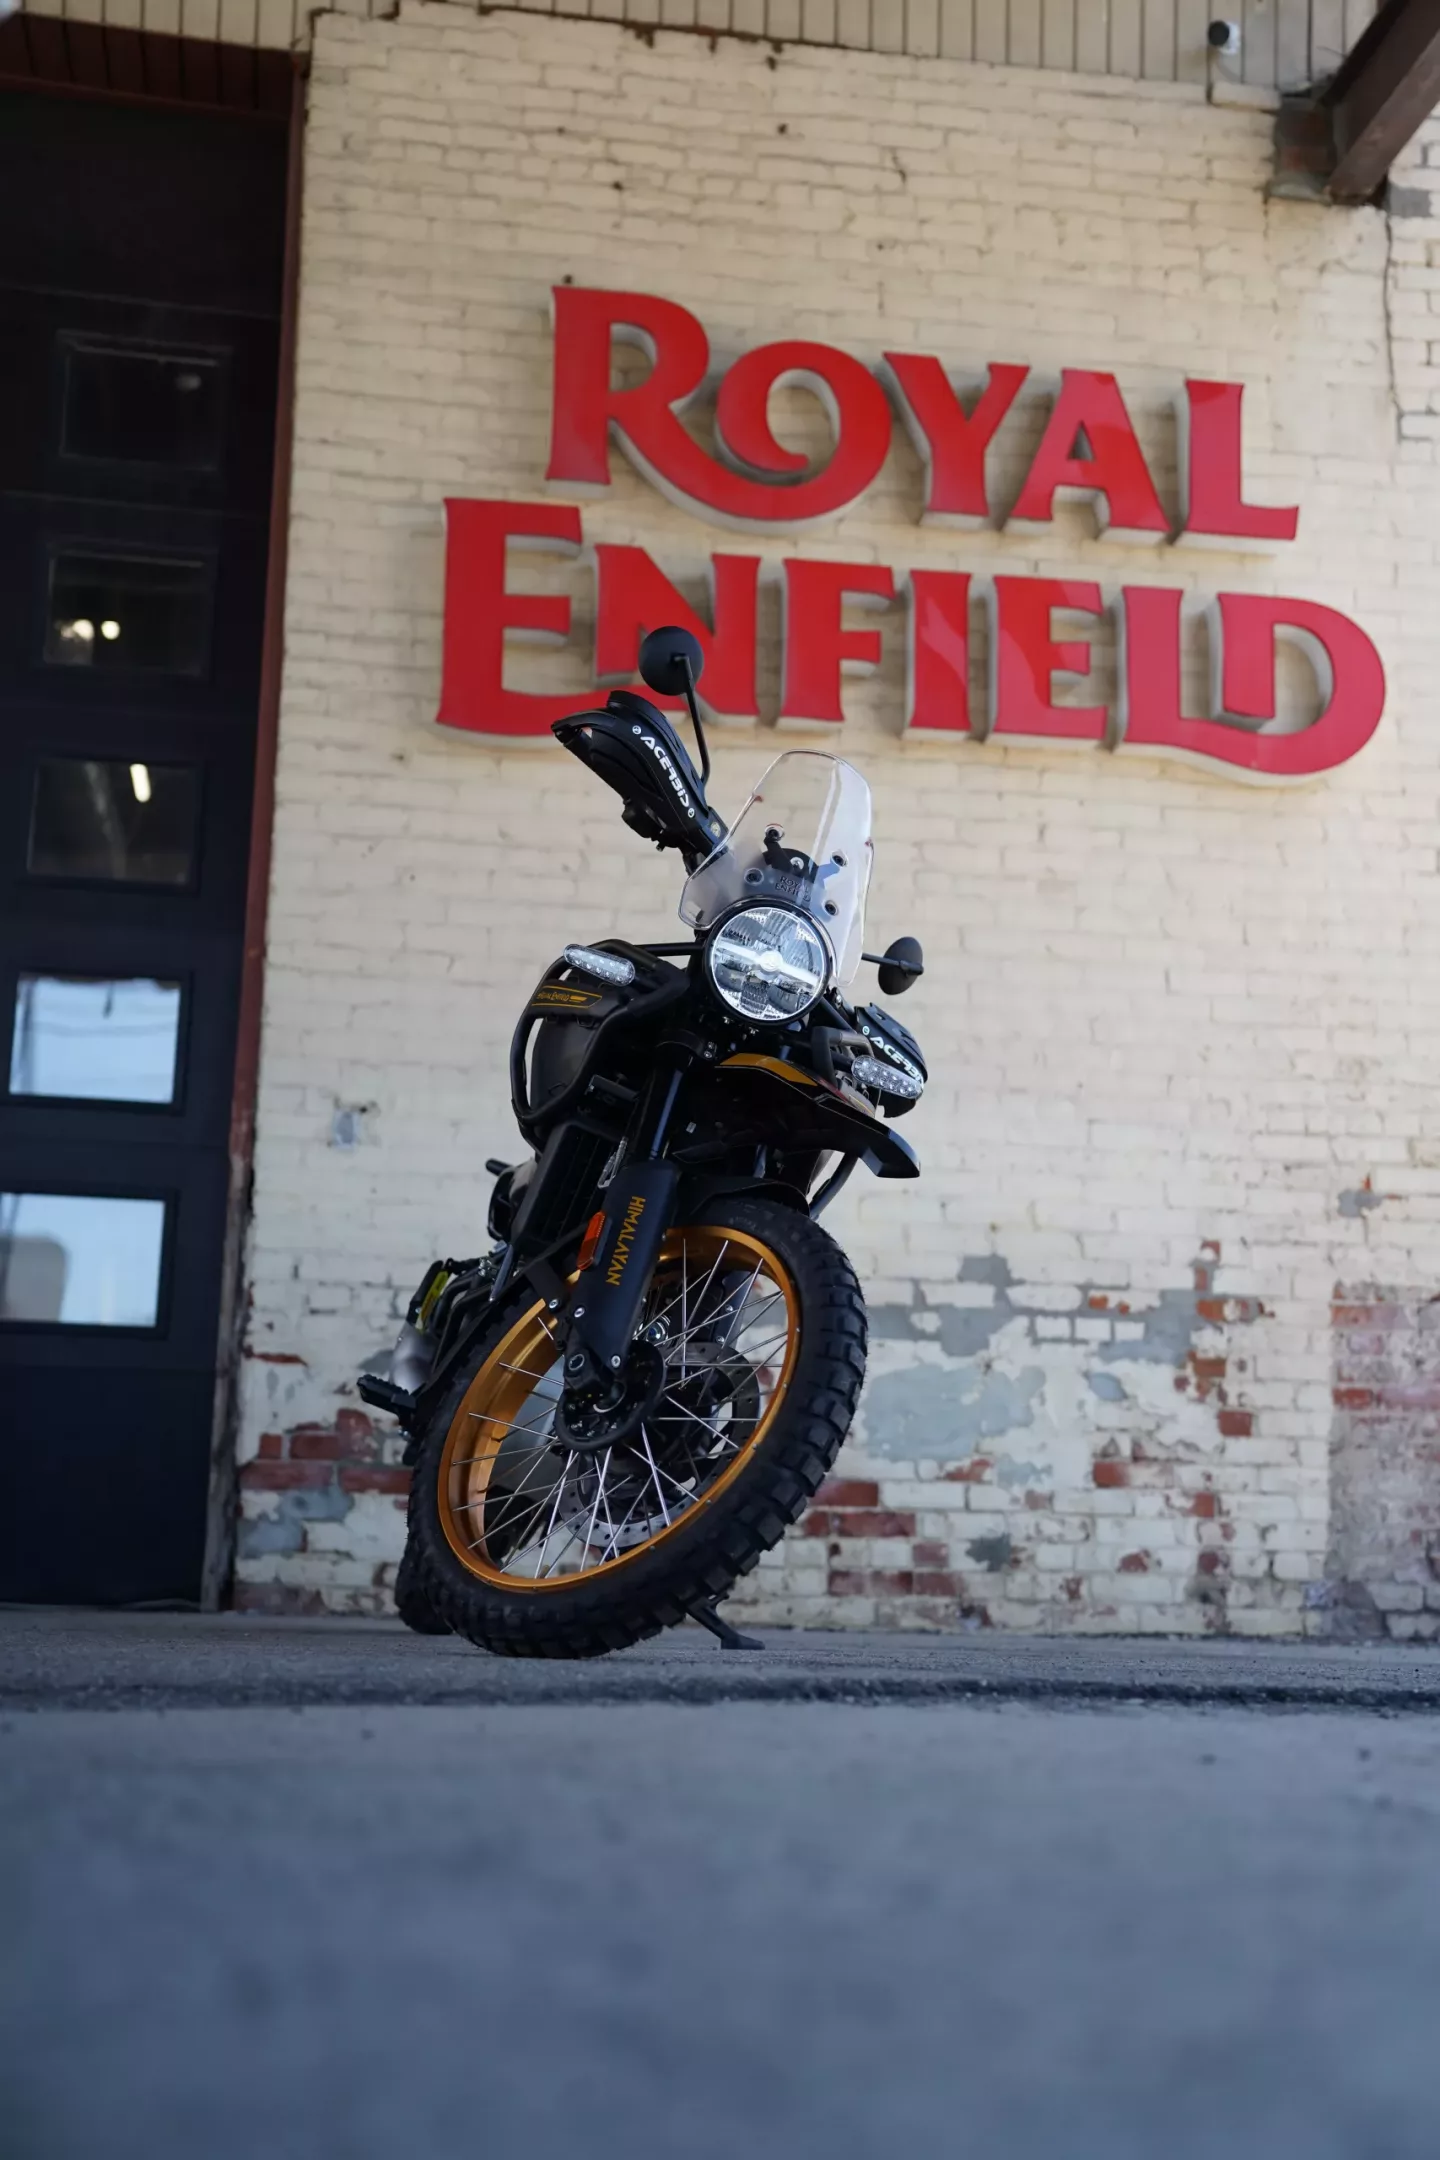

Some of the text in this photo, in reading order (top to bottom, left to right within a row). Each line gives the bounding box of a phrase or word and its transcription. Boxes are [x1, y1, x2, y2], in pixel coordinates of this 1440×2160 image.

[545, 285, 1301, 543] ROYAL
[436, 497, 1386, 778] ENFIELD
[640, 735, 690, 808] ACERBIS
[605, 1195, 646, 1286] HIMALAYAN
